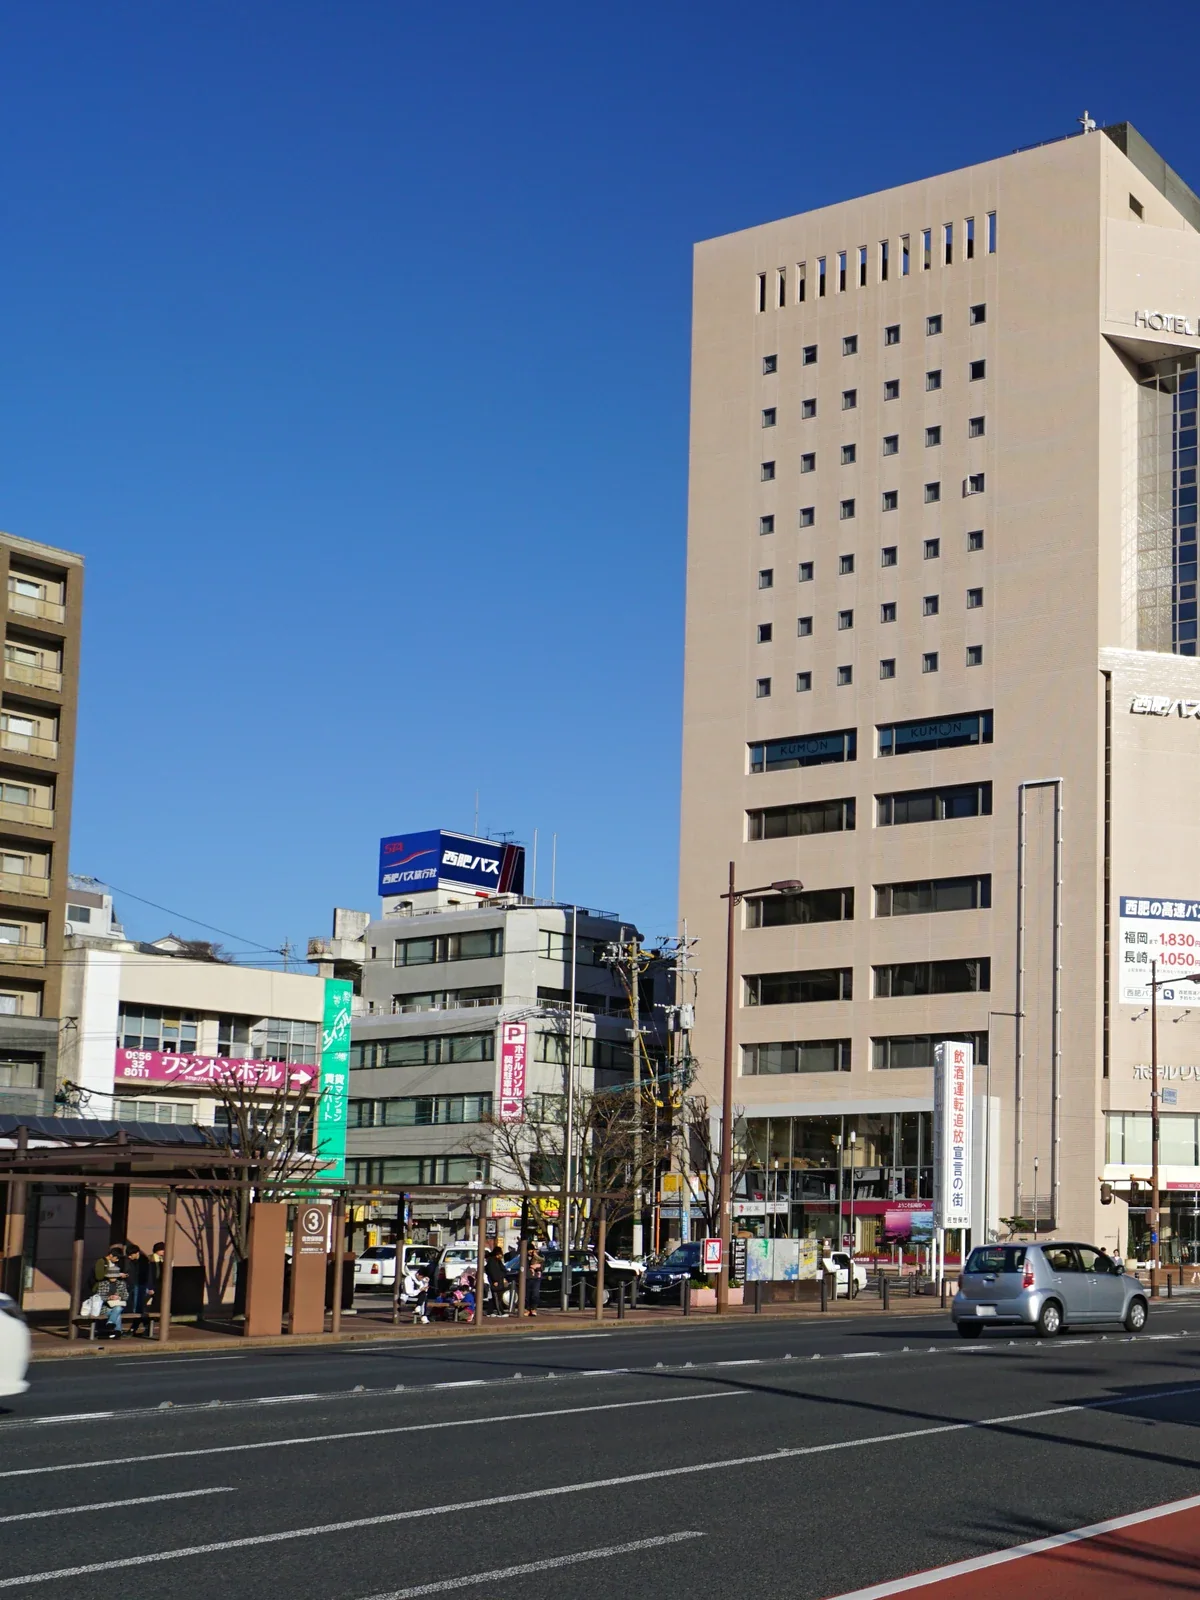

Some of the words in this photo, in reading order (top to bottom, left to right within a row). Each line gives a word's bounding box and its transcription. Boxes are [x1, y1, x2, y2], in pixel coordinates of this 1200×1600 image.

[1134, 309, 1195, 335] HOTEL
[910, 722, 962, 738] KUMON
[780, 739, 828, 756] KUMON
[442, 850, 499, 875] 西肥バス
[382, 868, 437, 884] 西肥バス旅行社
[508, 1027, 521, 1041] P
[124, 1067, 150, 1078] 8011
[131, 1060, 145, 1069] 32
[161, 1056, 283, 1083] ワシントンホテル
[513, 1045, 524, 1096] ホテルリソル
[952, 1049, 965, 1208] 飲酒運転追放宣言の街
